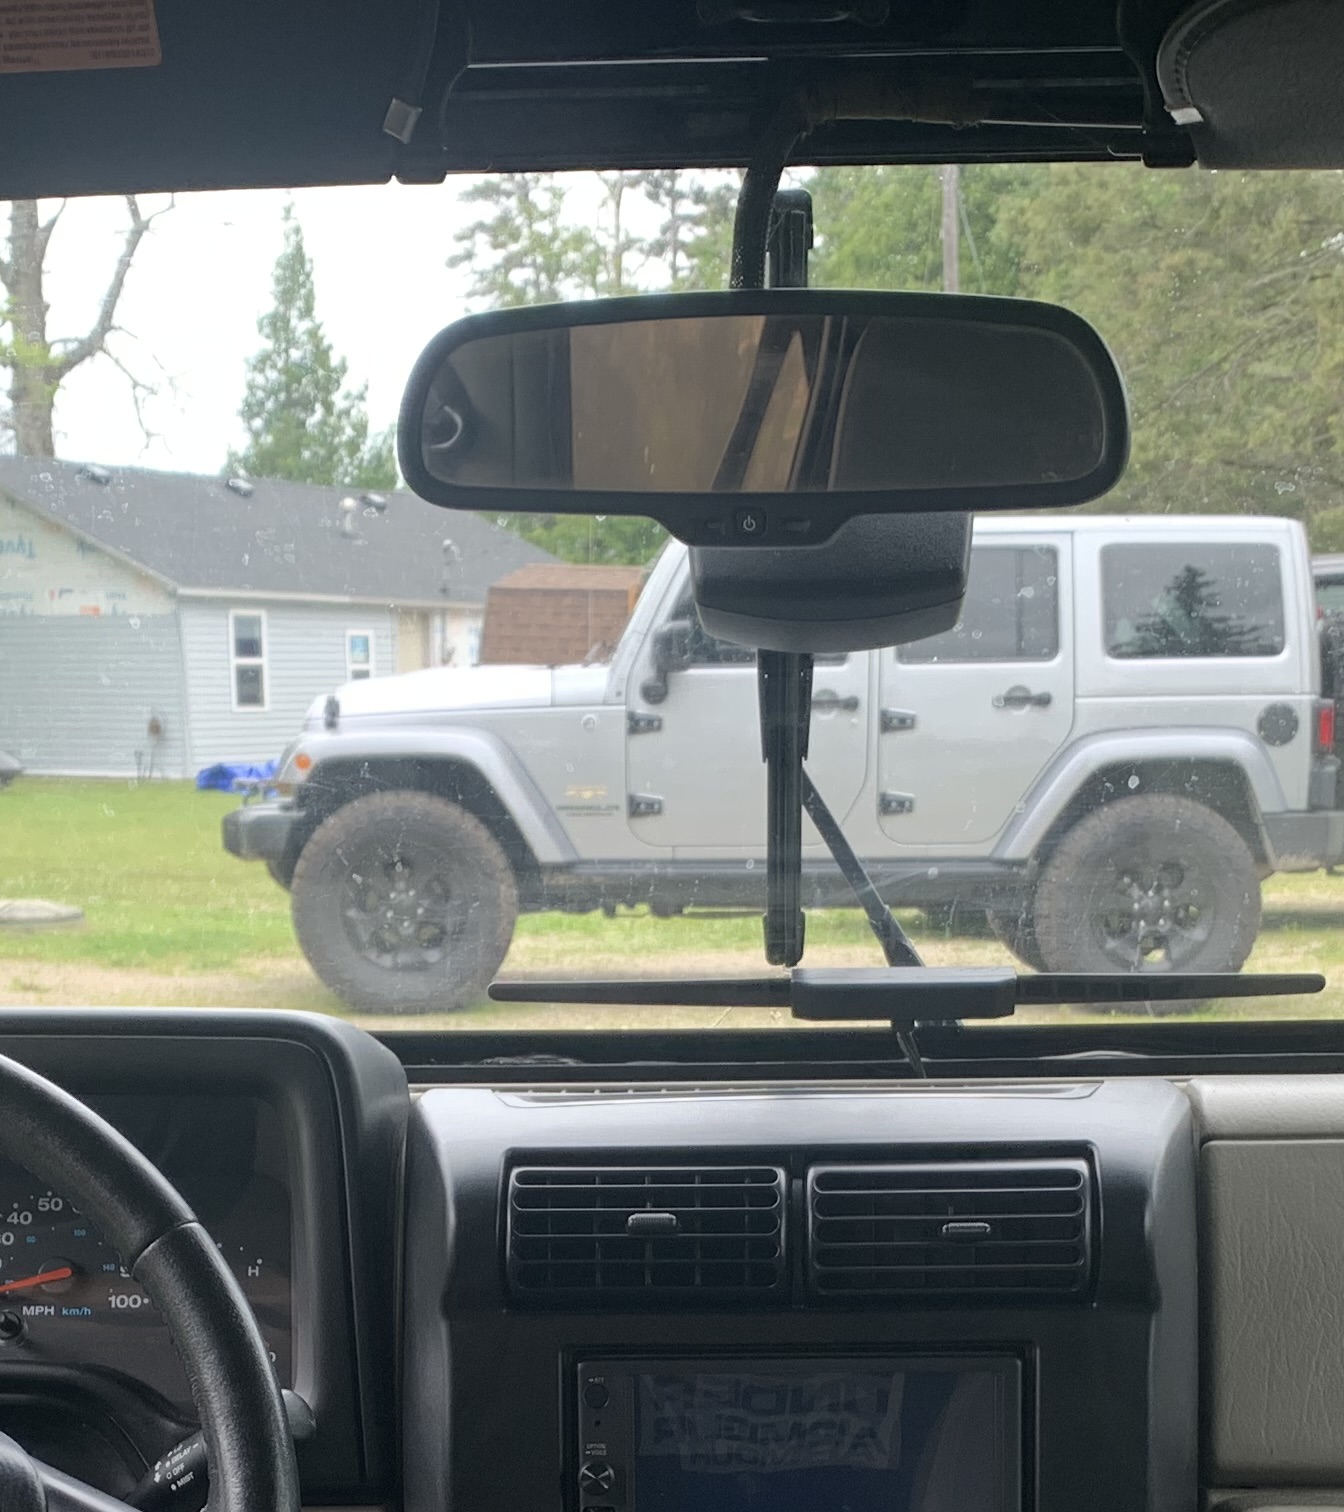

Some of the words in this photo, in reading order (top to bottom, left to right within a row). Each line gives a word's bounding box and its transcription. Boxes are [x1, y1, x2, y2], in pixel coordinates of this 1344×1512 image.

[37, 1197, 63, 1211] 50
[6, 1211, 32, 1225] 40
[248, 1266, 259, 1277] H
[108, 1295, 141, 1308] 100
[22, 1306, 55, 1316] MPH
[61, 1306, 91, 1316] km/h
